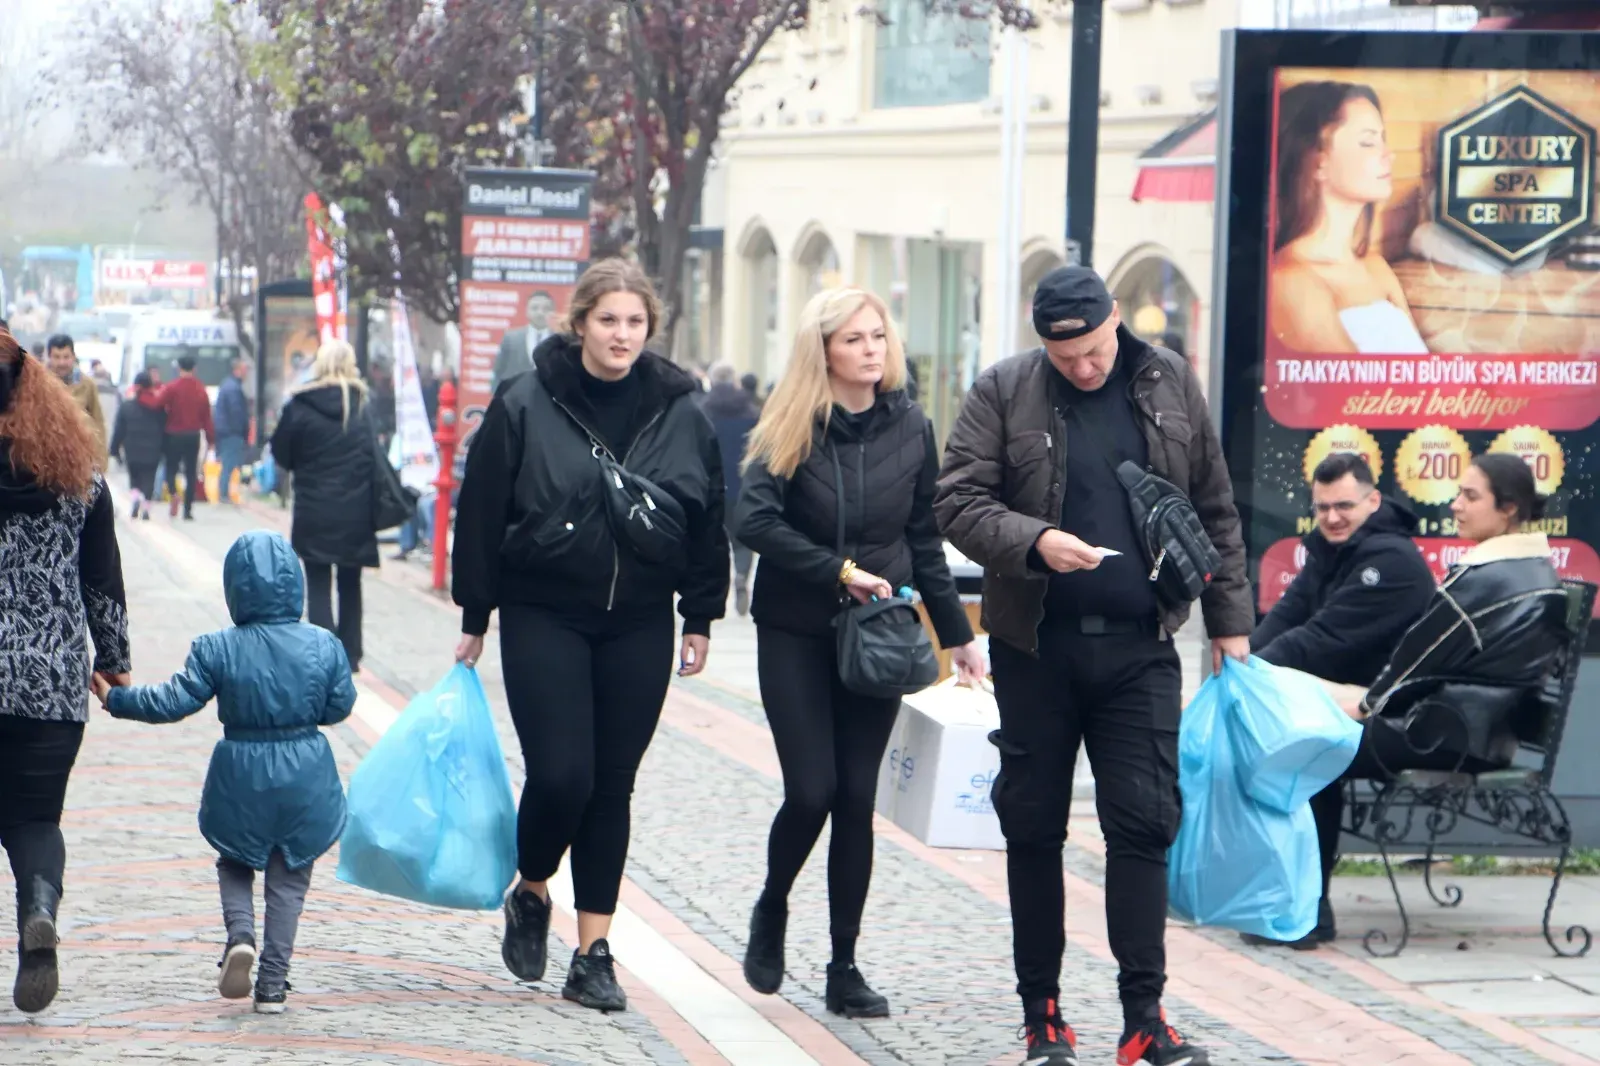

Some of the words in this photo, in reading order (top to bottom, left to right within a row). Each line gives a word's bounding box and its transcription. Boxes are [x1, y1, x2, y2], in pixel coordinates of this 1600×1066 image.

[1458, 135, 1577, 161] LUXURY
[1494, 173, 1539, 192] SPA
[1467, 203, 1561, 224] CENTER
[1276, 359, 1387, 383] TRAKYA'NIN
[1390, 360, 1415, 383] EN
[1417, 355, 1477, 384] BÜYÜK
[1481, 360, 1517, 384] SPA
[1342, 387, 1426, 416] sizleri
[1424, 387, 1529, 427] bekliyor
[1513, 441, 1540, 450] SAUNA
